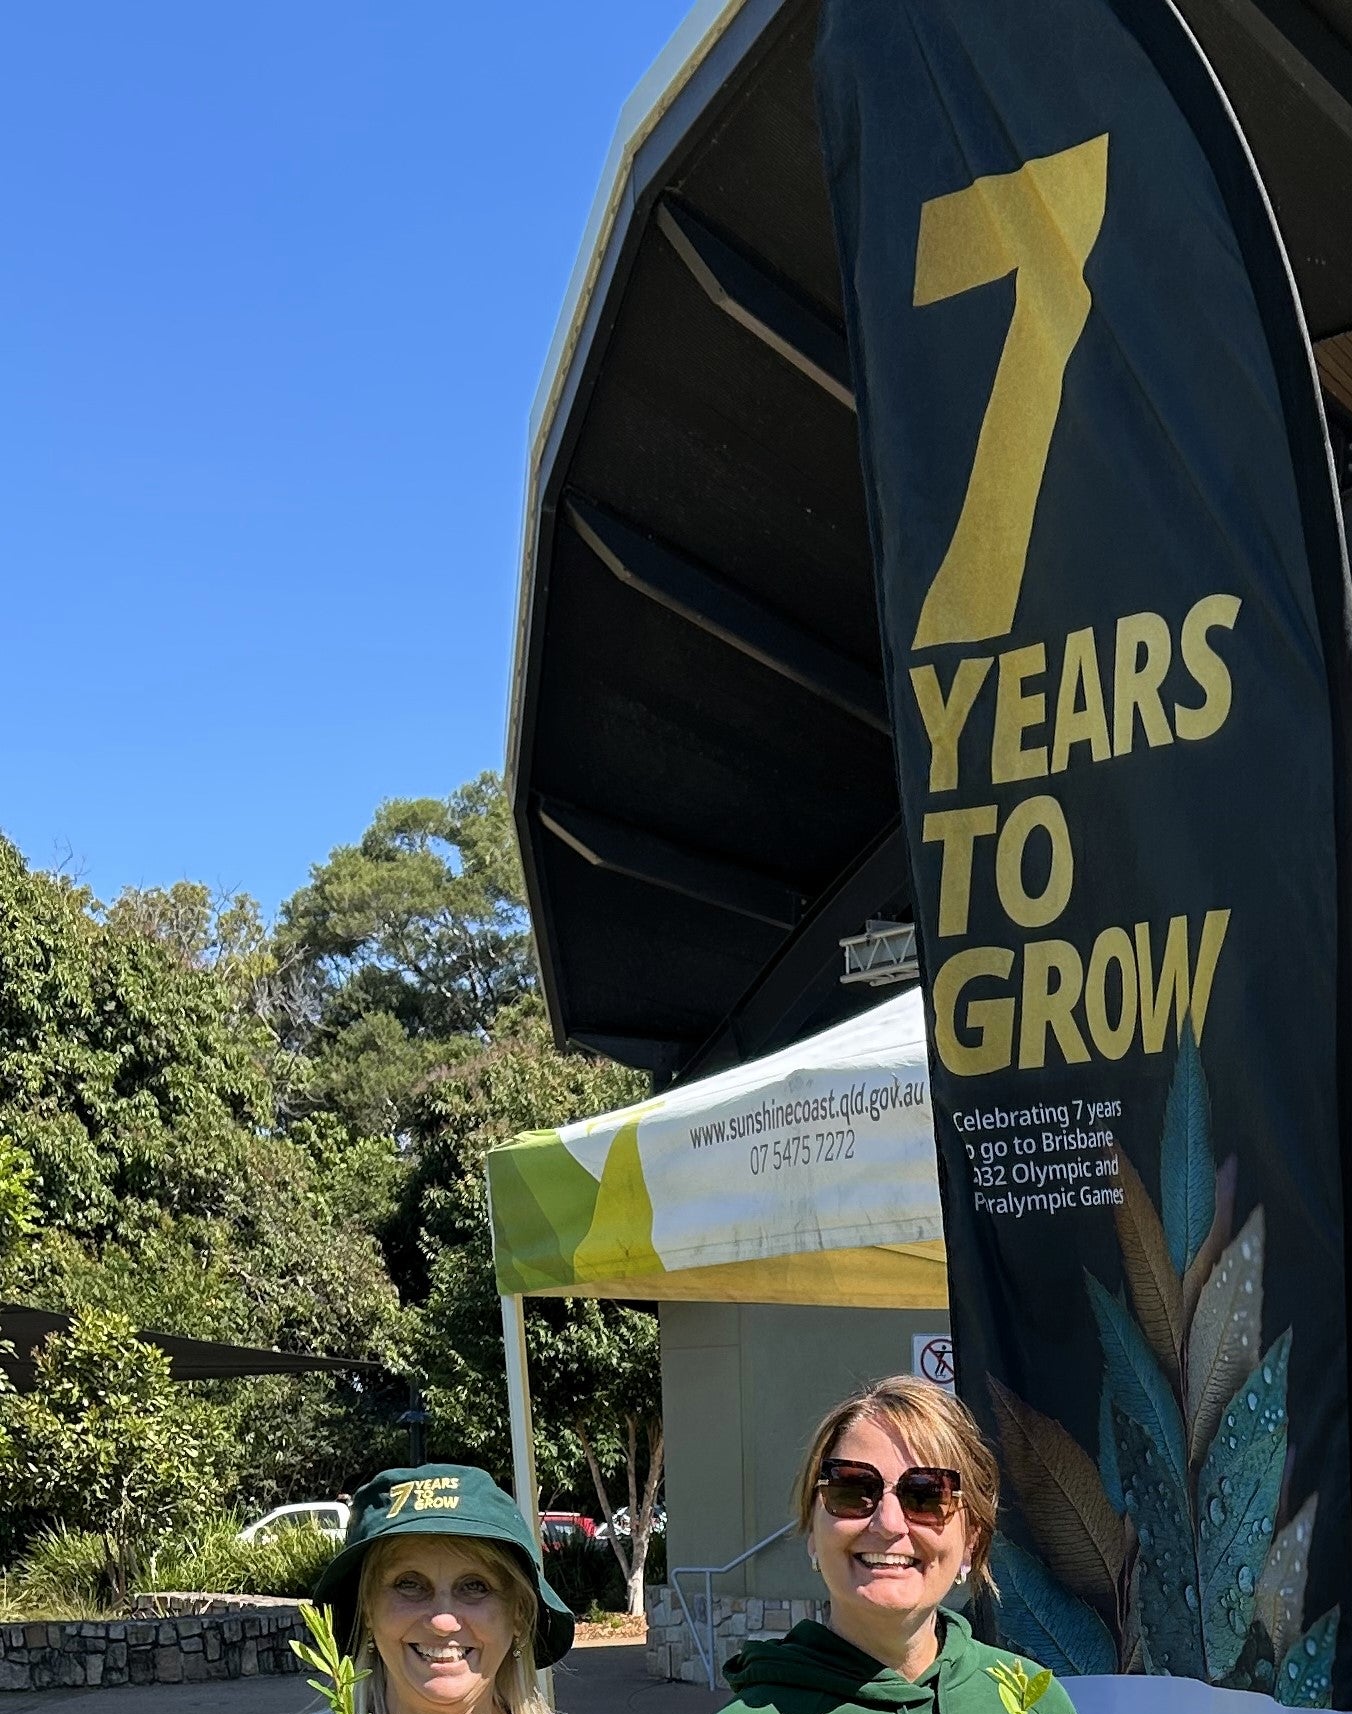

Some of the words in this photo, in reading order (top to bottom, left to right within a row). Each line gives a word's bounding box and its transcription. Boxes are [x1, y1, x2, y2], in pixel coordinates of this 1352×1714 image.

[913, 133, 1109, 651] 7
[908, 594, 1242, 792] YEARS
[922, 795, 1074, 937] TO
[932, 908, 1231, 1077] GROW
[689, 1081, 925, 1149] www.sunshinecoast.qld.gov.au
[952, 1102, 1069, 1132] Celebrating
[1072, 1100, 1083, 1121] 7
[1087, 1099, 1122, 1126] years
[750, 1144, 769, 1175] 07
[773, 1134, 811, 1171] 5475
[816, 1129, 855, 1163] 7272
[981, 1141, 1007, 1164] go
[1013, 1136, 1036, 1156] to
[1041, 1128, 1114, 1152] Brisbane
[973, 1165, 1007, 1187] 32
[1012, 1157, 1092, 1187] Olympic
[1095, 1154, 1119, 1176] and
[1080, 1185, 1124, 1206] Games
[386, 1481, 415, 1519] 7
[414, 1477, 460, 1490] YEARS
[414, 1489, 434, 1501] TO
[414, 1496, 460, 1511] GROW
